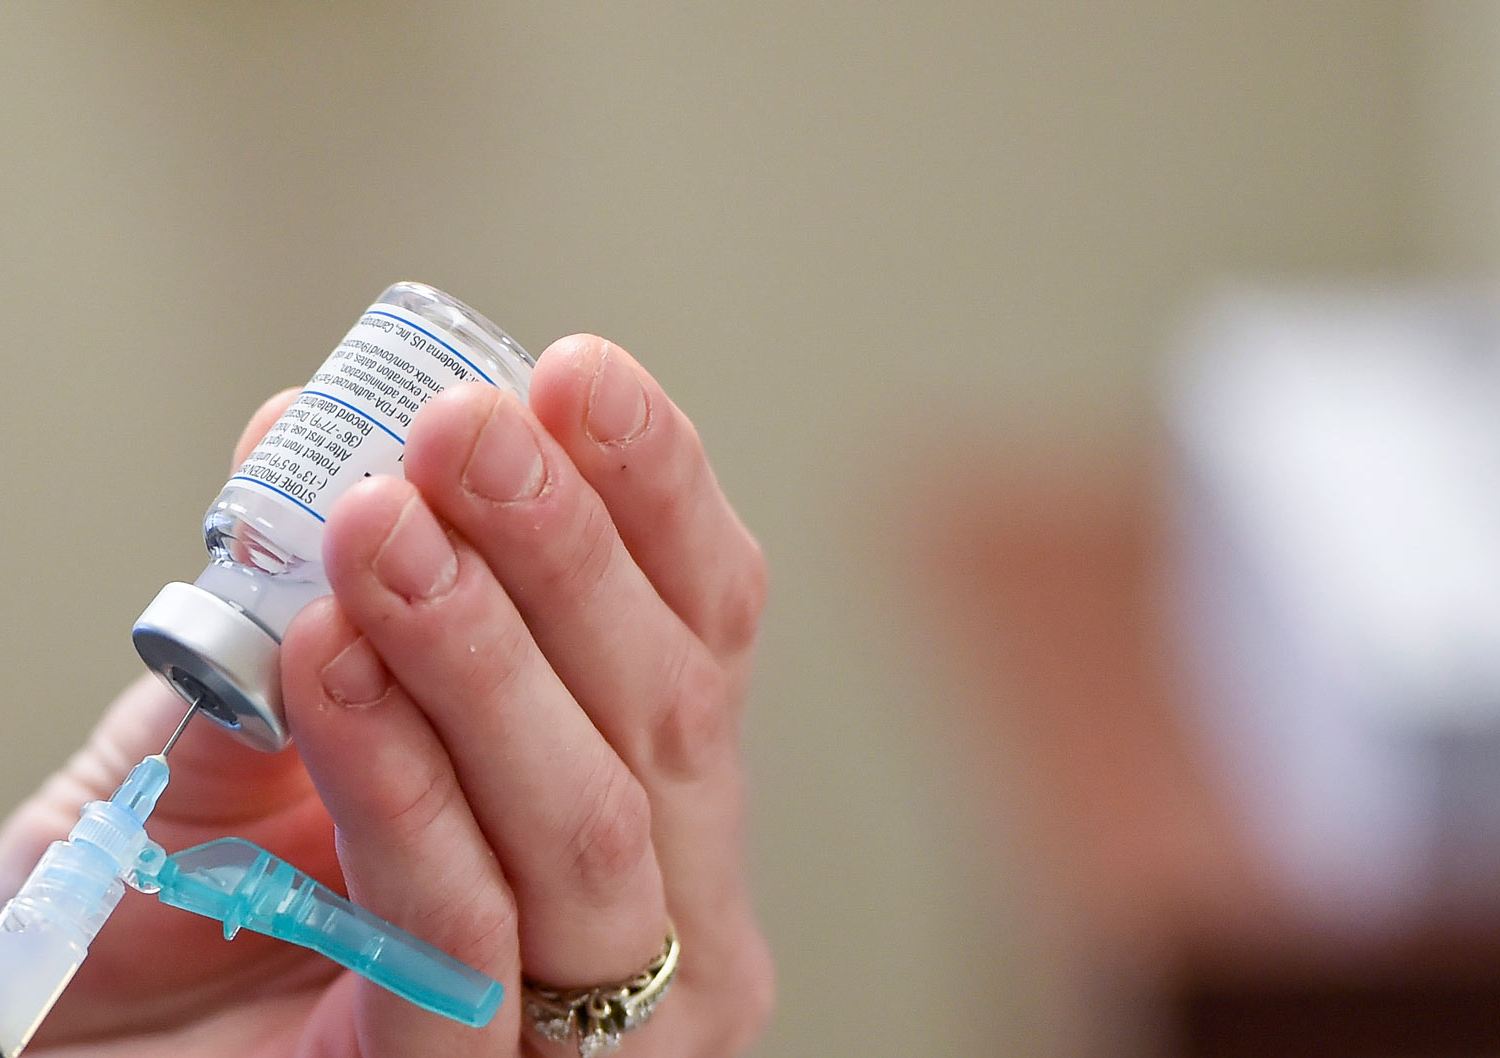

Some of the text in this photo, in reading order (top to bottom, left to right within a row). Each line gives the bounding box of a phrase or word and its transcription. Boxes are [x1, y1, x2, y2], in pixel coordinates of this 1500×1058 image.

[409, 331, 426, 350] US,
[353, 352, 377, 369] dates,
[425, 343, 468, 380] Moderna
[375, 363, 422, 396] expiration
[329, 375, 397, 417] FDA-authorized
[396, 394, 419, 412] and
[290, 423, 307, 435] use,
[333, 407, 374, 436] Record
[395, 411, 412, 427] for
[303, 429, 326, 447] first
[308, 412, 363, 448] (36°-77°F).
[281, 438, 304, 454] from
[323, 440, 352, 462] After
[268, 452, 290, 470] 5°F)
[287, 462, 300, 475] to
[301, 446, 341, 476] Protect
[248, 464, 316, 504] STORE FROZEN
[295, 470, 328, 491] (-13°
